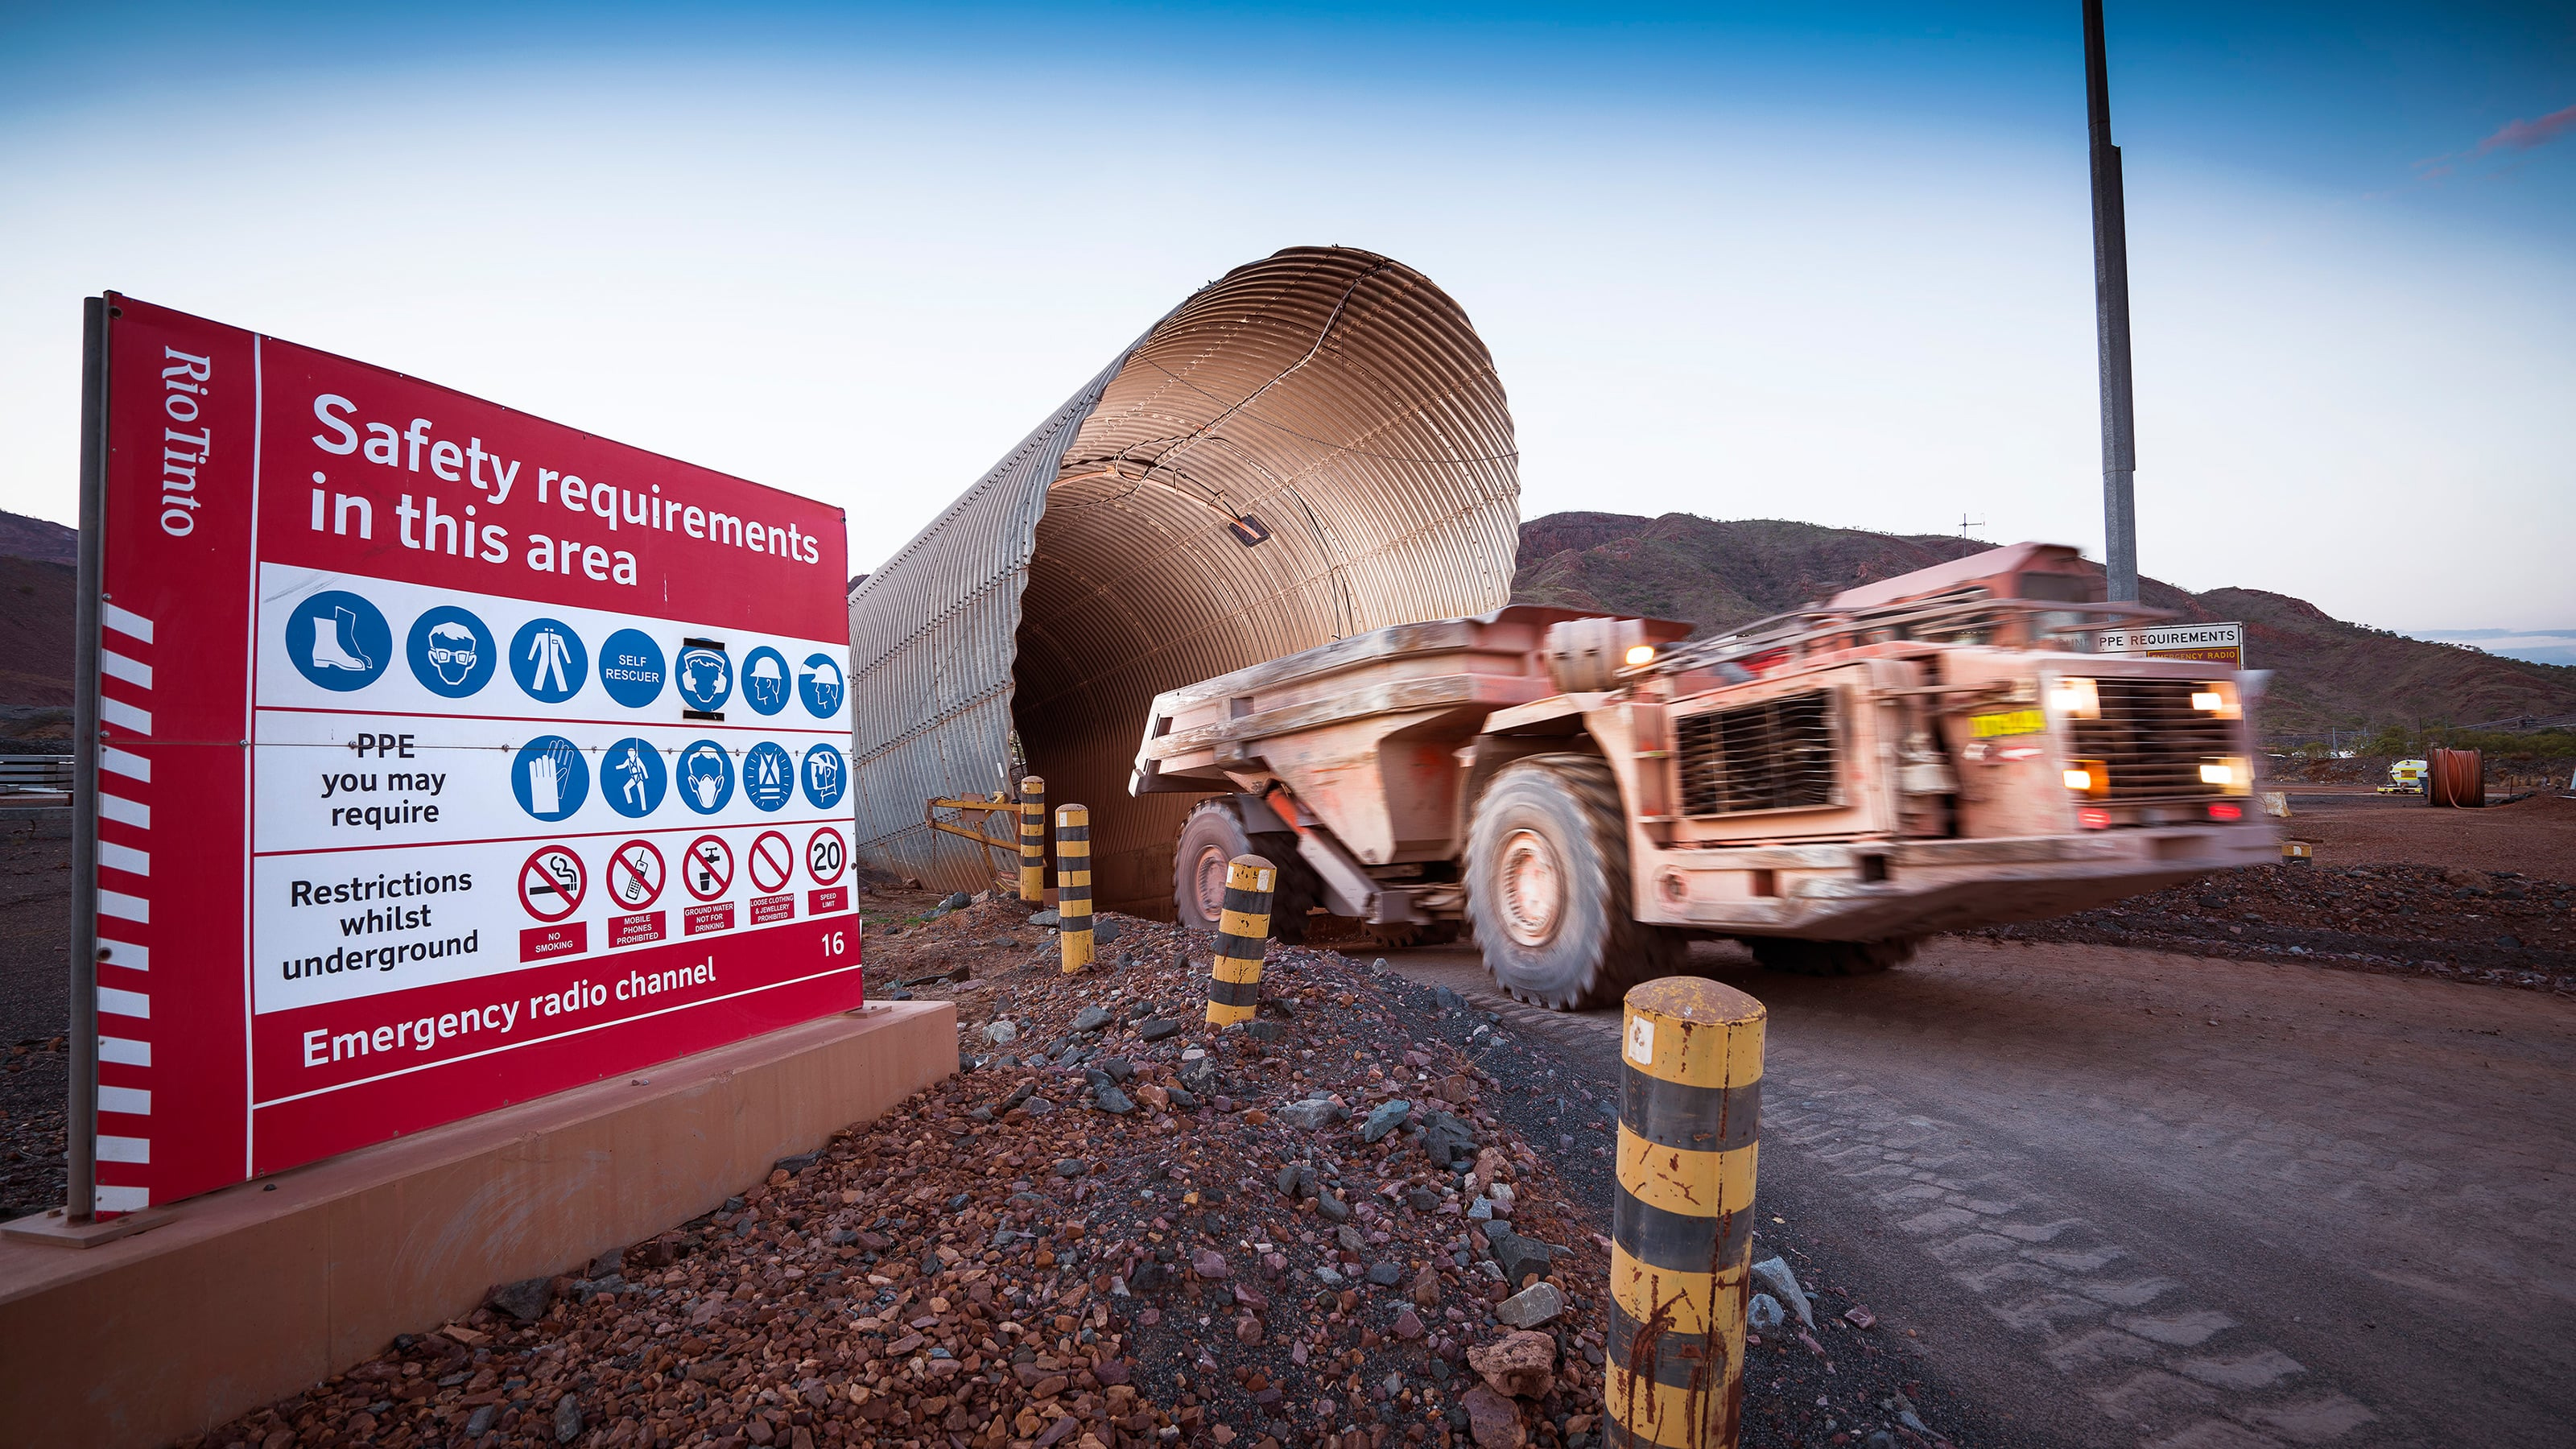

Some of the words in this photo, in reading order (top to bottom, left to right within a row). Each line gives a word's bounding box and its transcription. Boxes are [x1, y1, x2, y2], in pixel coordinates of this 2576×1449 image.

[312, 394, 521, 505] Safety
[538, 467, 819, 564] requirements
[312, 471, 374, 540] in
[395, 493, 510, 564] this
[526, 533, 638, 586] area
[2099, 636, 2124, 647] PPE
[2130, 630, 2235, 646] REQUIREMENTS
[618, 654, 647, 667] SELF
[2207, 650, 2235, 659] RADIO
[605, 669, 659, 683] RESCUER
[357, 733, 415, 758] PPE
[321, 773, 377, 799] you
[388, 773, 447, 795] may
[332, 799, 440, 831] require
[814, 841, 840, 871] 20
[291, 871, 473, 907] Restrictions
[750, 898, 768, 906] LOOSE
[769, 894, 794, 903] CLOTHING
[819, 892, 836, 901] SPEED
[685, 907, 712, 916] GROUND
[712, 903, 733, 912] WATER
[761, 904, 790, 914] JEWELLERY
[340, 904, 431, 936] whilst
[624, 914, 651, 923] MOBILE
[712, 914, 724, 922] FOR
[758, 912, 788, 921] PROHIBITED
[623, 924, 652, 934] PHONES
[695, 922, 724, 932] DRINKING
[548, 932, 560, 940] NO
[617, 932, 658, 944] PROHIBITED
[535, 940, 573, 953] SMOKING
[821, 931, 844, 956] 16
[283, 929, 478, 980] underground
[303, 1001, 519, 1067] Emergency
[530, 980, 607, 1019] radio
[616, 956, 716, 1001] channel
